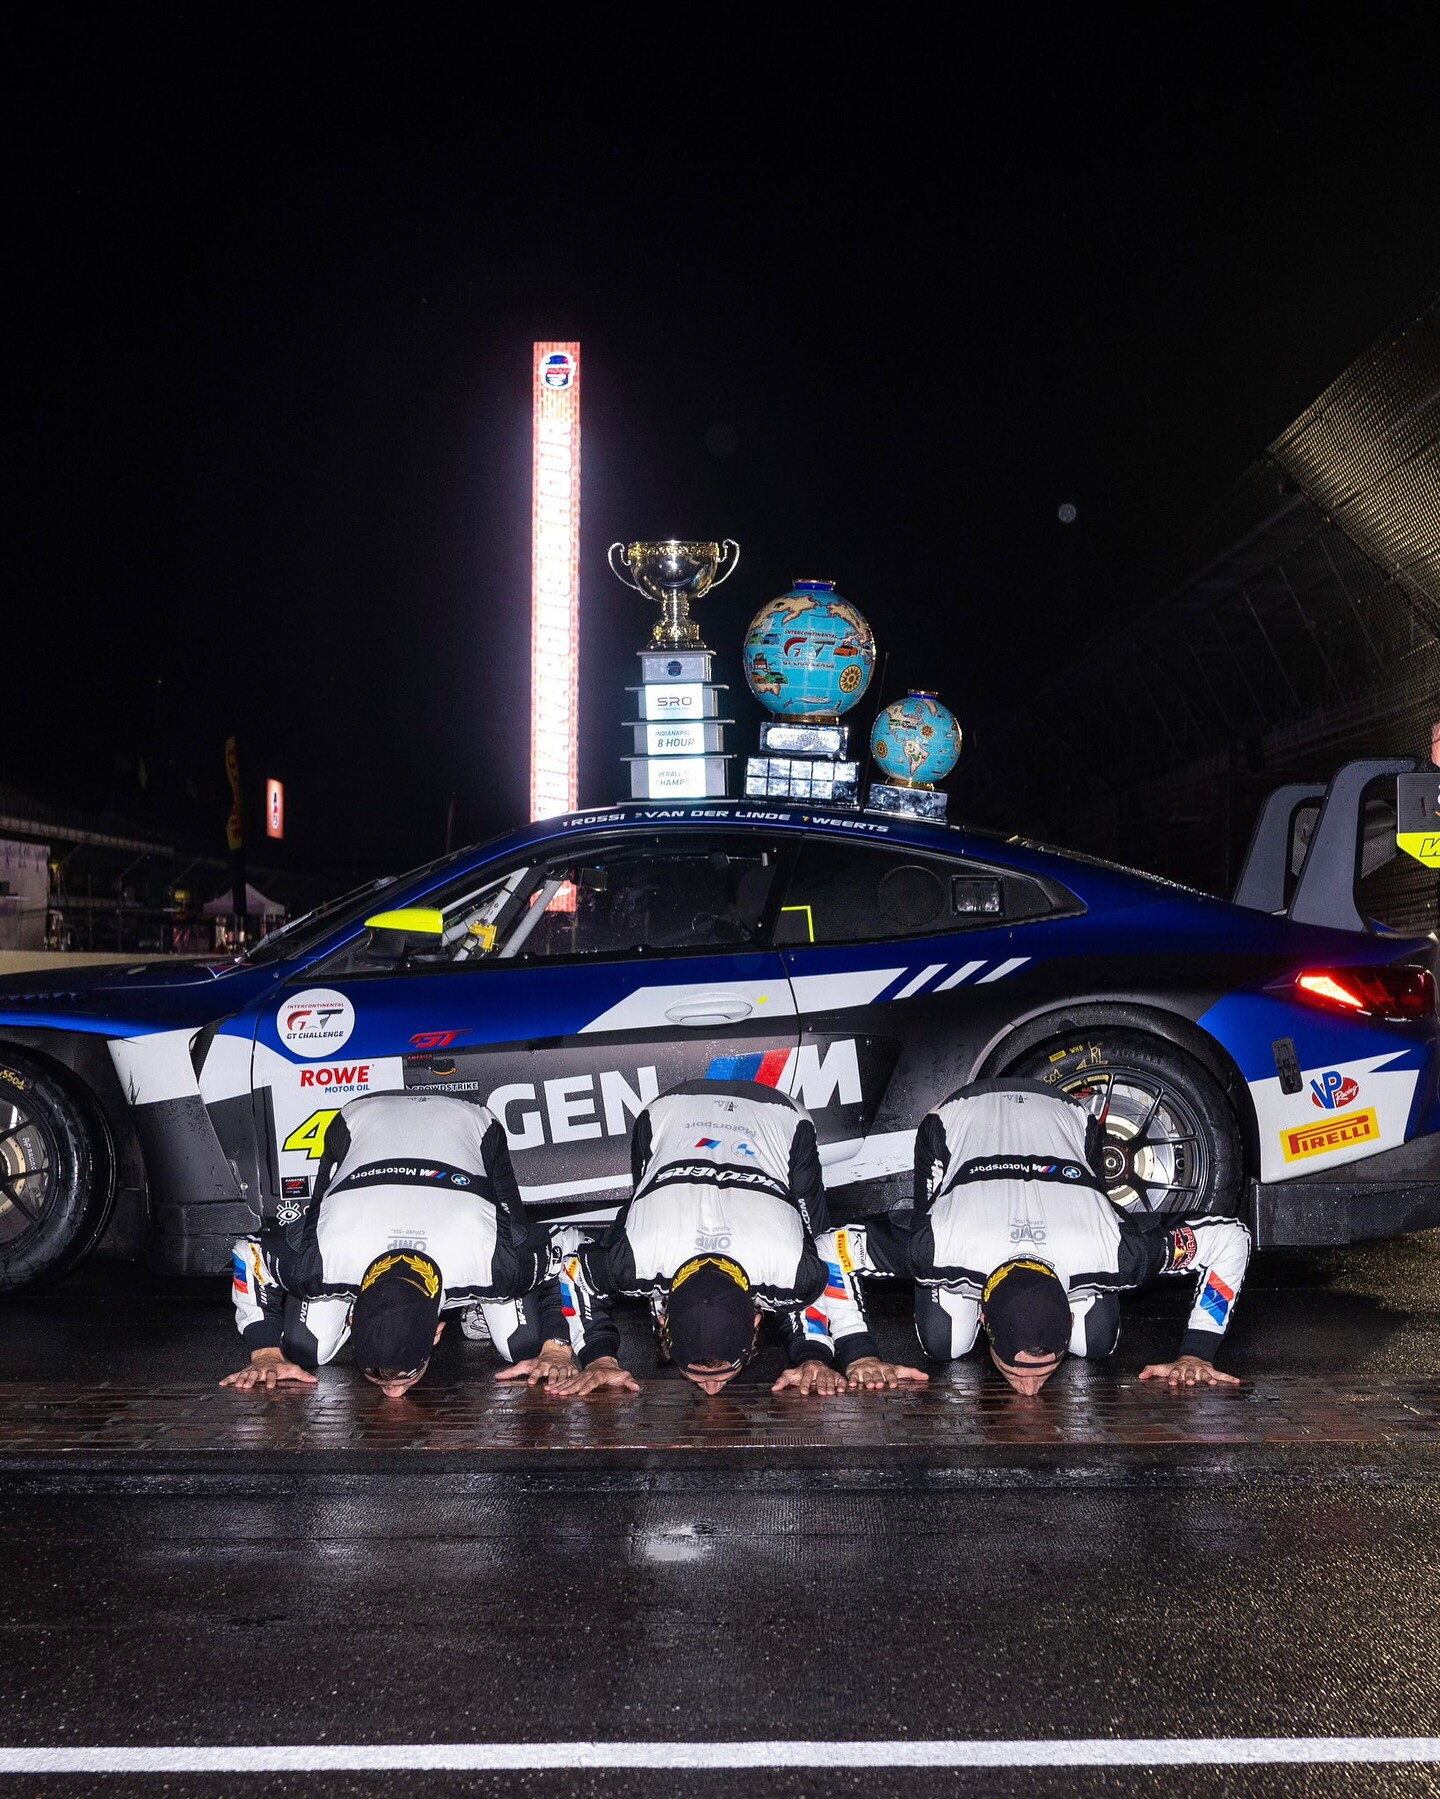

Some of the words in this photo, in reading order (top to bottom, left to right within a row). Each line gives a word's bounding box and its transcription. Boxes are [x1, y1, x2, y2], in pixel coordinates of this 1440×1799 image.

[540, 419, 572, 526] HOUR
[657, 696, 693, 706] SRO
[657, 738, 664, 748] 8
[666, 737, 695, 748] HOUR
[570, 814, 625, 826] ROSSI
[643, 810, 685, 819] VAN
[690, 810, 729, 818] DER
[735, 811, 791, 821] LINDE
[808, 816, 890, 833] WEERTS
[287, 1002, 344, 1010] INTERCONTINENTAL
[286, 1032, 297, 1040] GT
[298, 1030, 344, 1039] CHALLENGE
[299, 1065, 370, 1087] ROWE
[324, 1084, 356, 1094] MOTOR
[356, 1083, 371, 1091] OIL
[1309, 1070, 1344, 1109] VP
[1335, 1084, 1359, 1105] Racing
[487, 1065, 659, 1151] GEN
[685, 1120, 757, 1138] Motorsport
[1288, 1114, 1370, 1155] PIRELLI
[350, 1167, 417, 1180] Motorsport
[969, 1163, 1030, 1175] Motorsport
[386, 1240, 427, 1252] OMP
[694, 1236, 731, 1250] OMP
